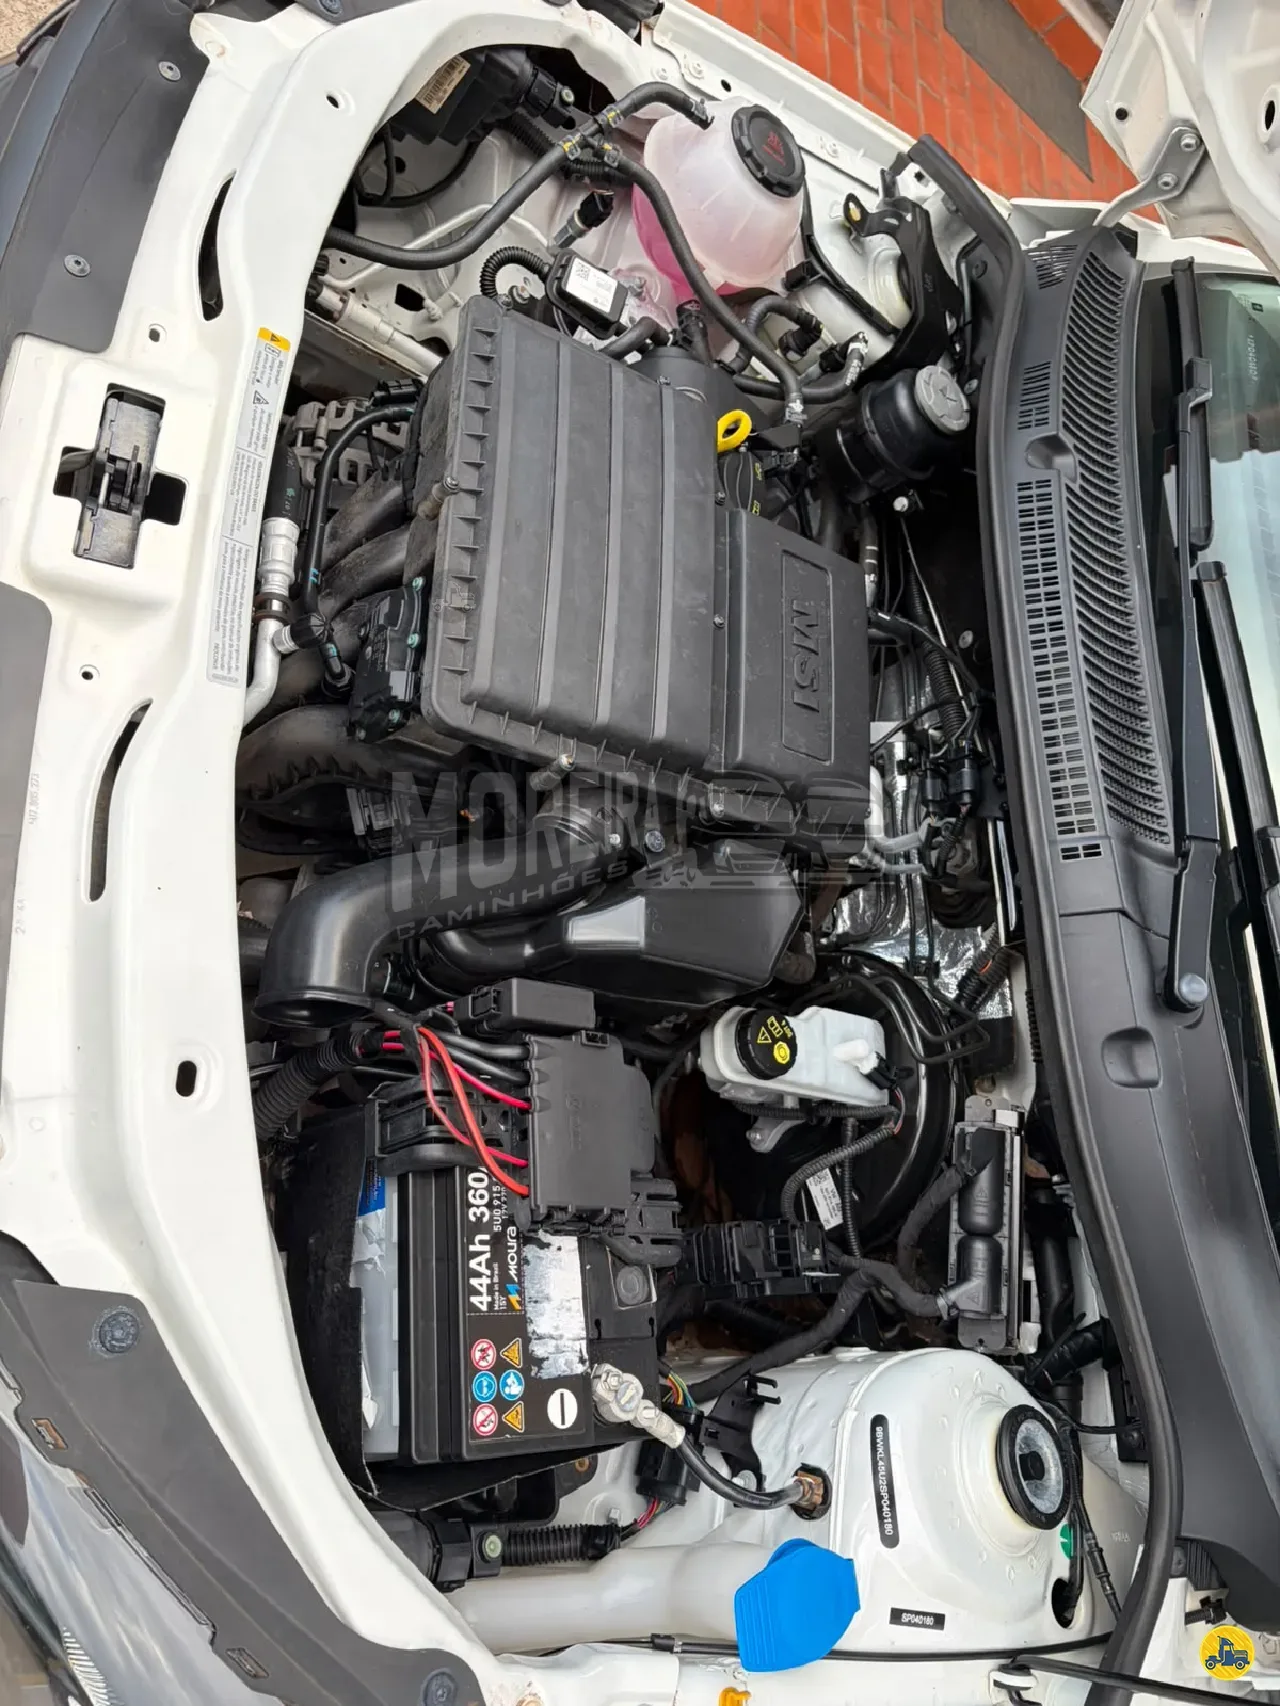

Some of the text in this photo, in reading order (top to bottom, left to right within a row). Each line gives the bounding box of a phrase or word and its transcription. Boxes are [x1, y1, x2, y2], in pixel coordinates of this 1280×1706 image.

[791, 599, 820, 713] MSI
[492, 1185, 501, 1206] 915
[468, 1234, 492, 1312] 44Ah
[493, 1283, 500, 1291] in
